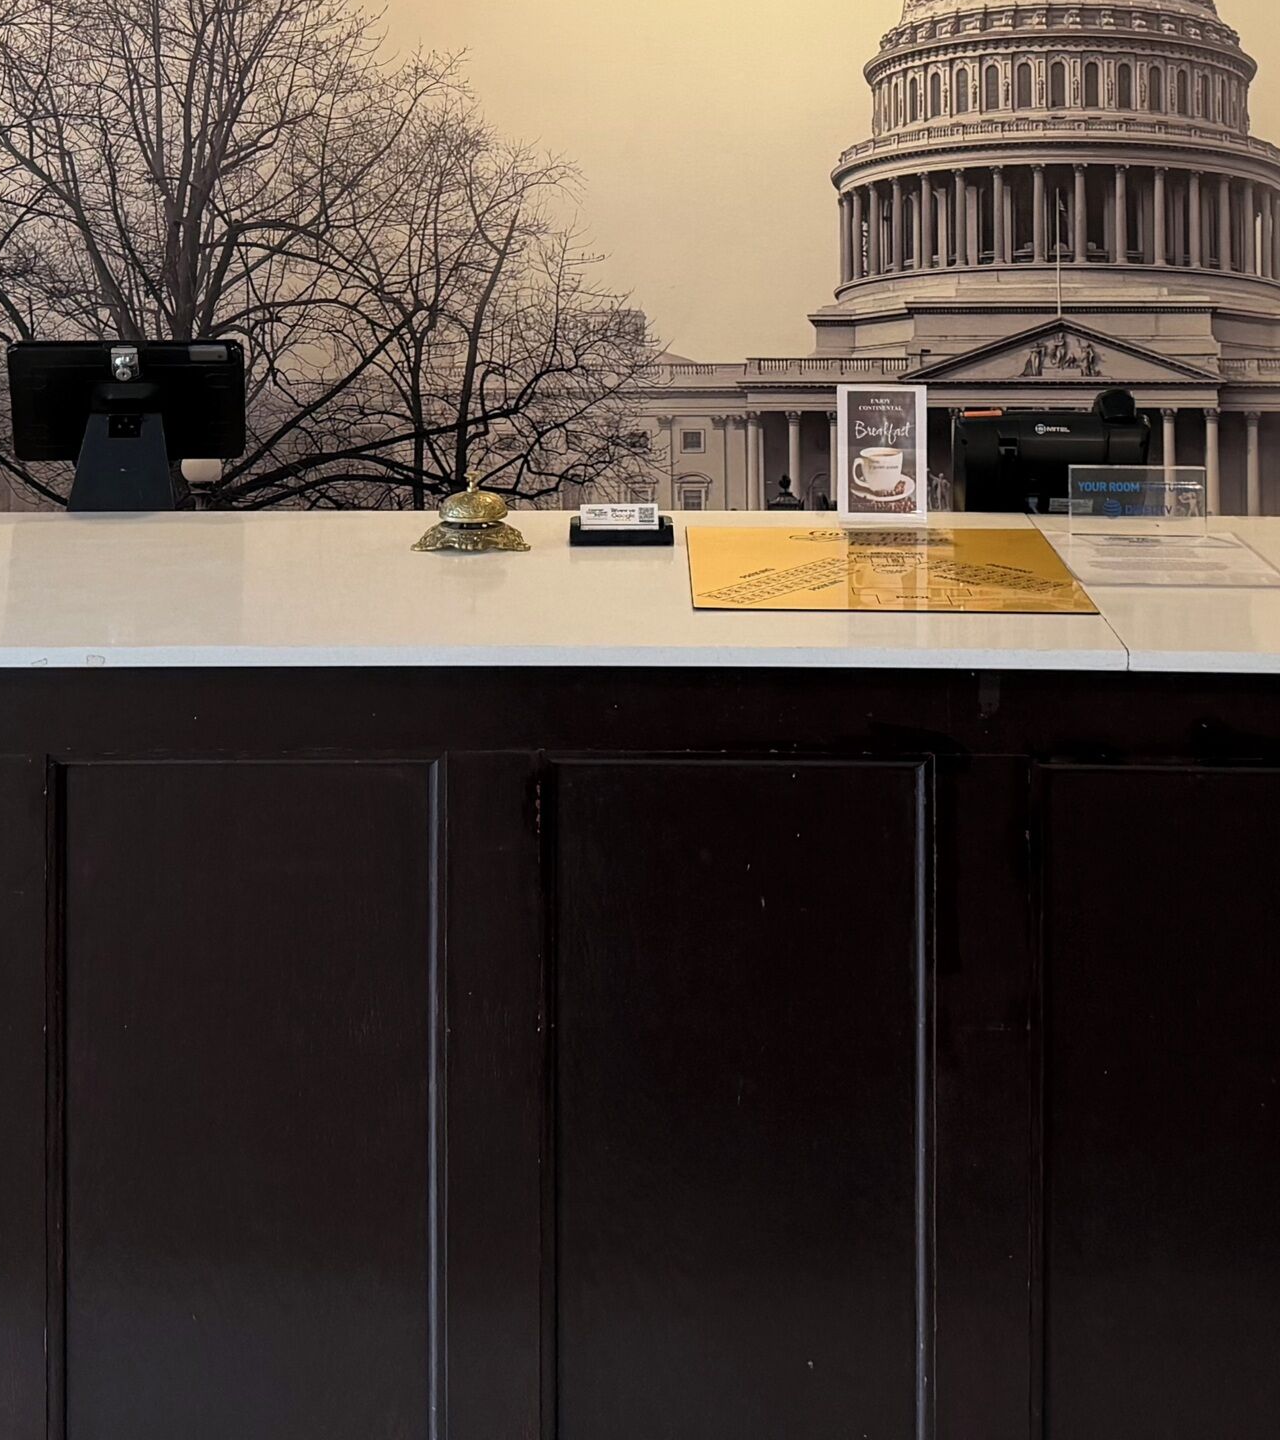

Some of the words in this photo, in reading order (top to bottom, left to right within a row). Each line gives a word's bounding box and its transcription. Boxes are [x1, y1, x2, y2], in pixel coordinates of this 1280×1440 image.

[854, 420, 913, 445] Breakfast
[1078, 481, 1107, 492] YOUR
[1108, 481, 1140, 492] ROOM
